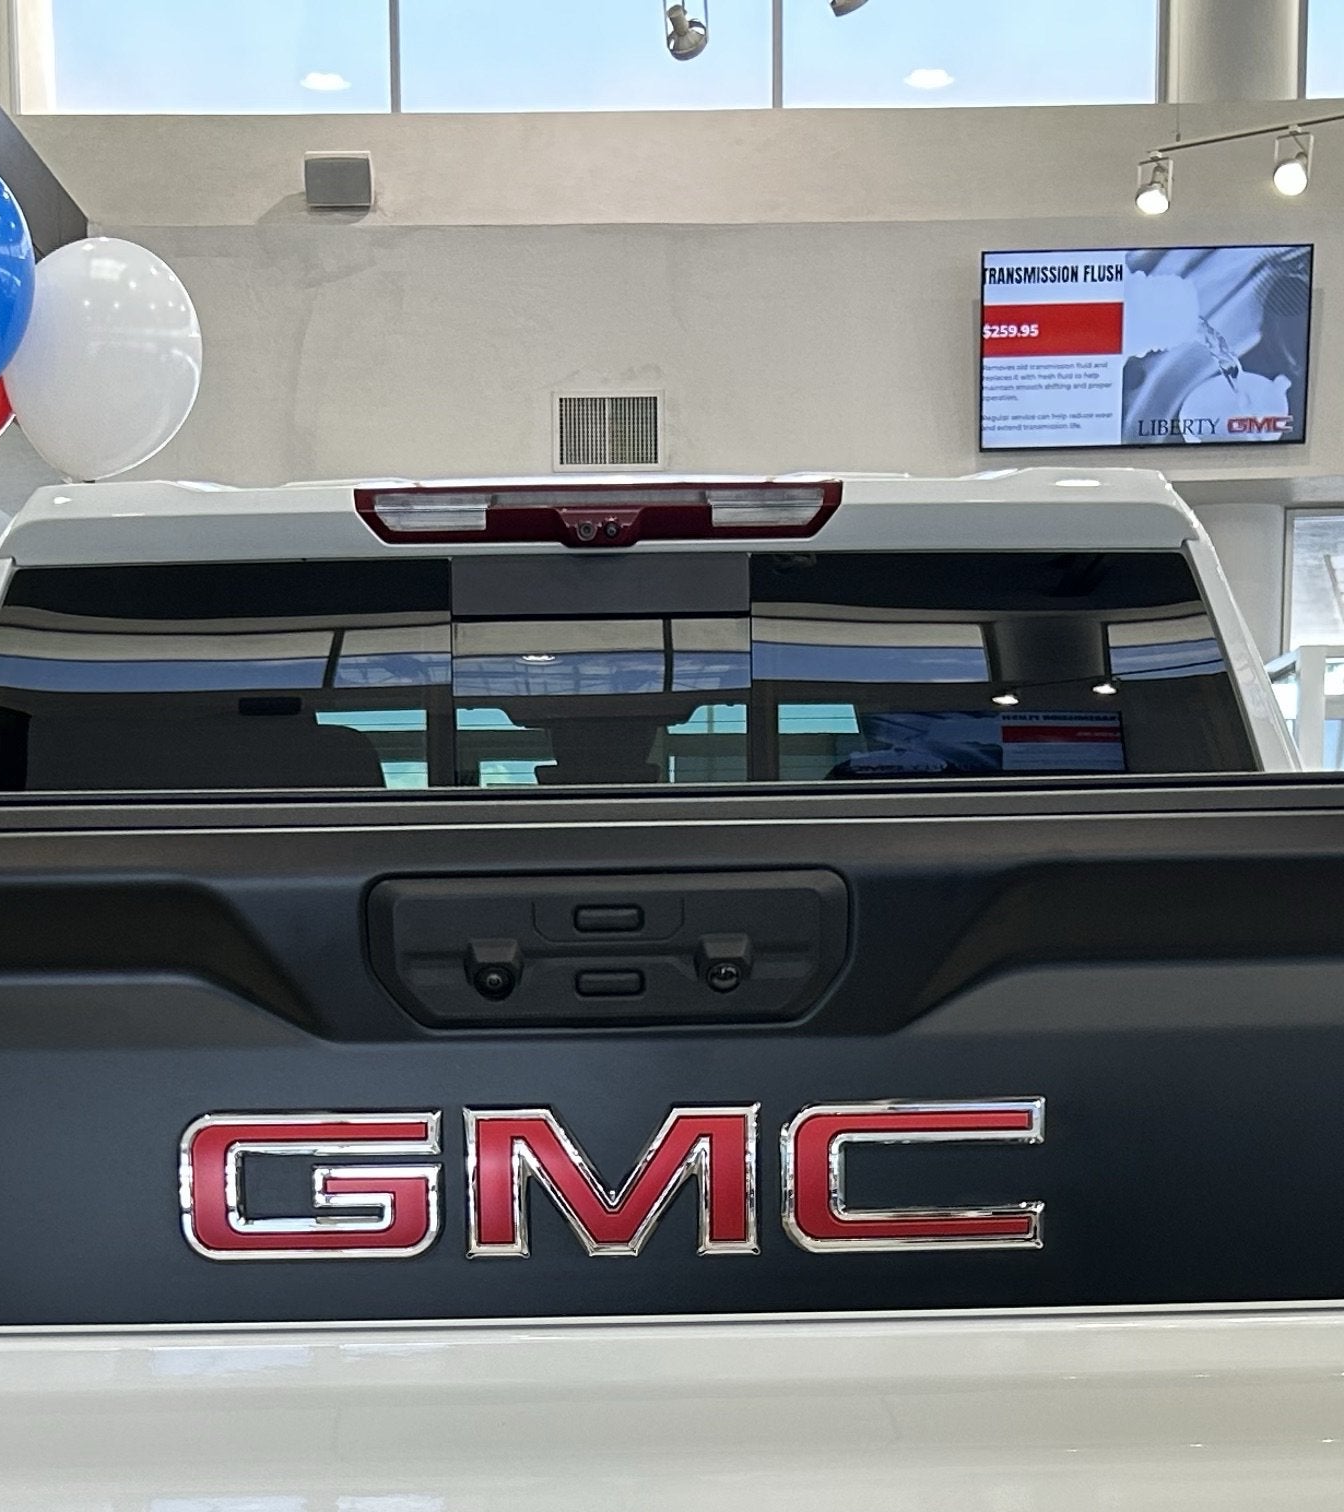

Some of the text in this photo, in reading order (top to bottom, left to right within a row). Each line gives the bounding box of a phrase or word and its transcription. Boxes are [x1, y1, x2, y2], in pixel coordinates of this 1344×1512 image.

[1083, 264, 1123, 283] FLUSH
[982, 323, 1039, 339] $259.95
[1138, 415, 1294, 437] LIBERTY GMC
[179, 1095, 1047, 1262] GMC
